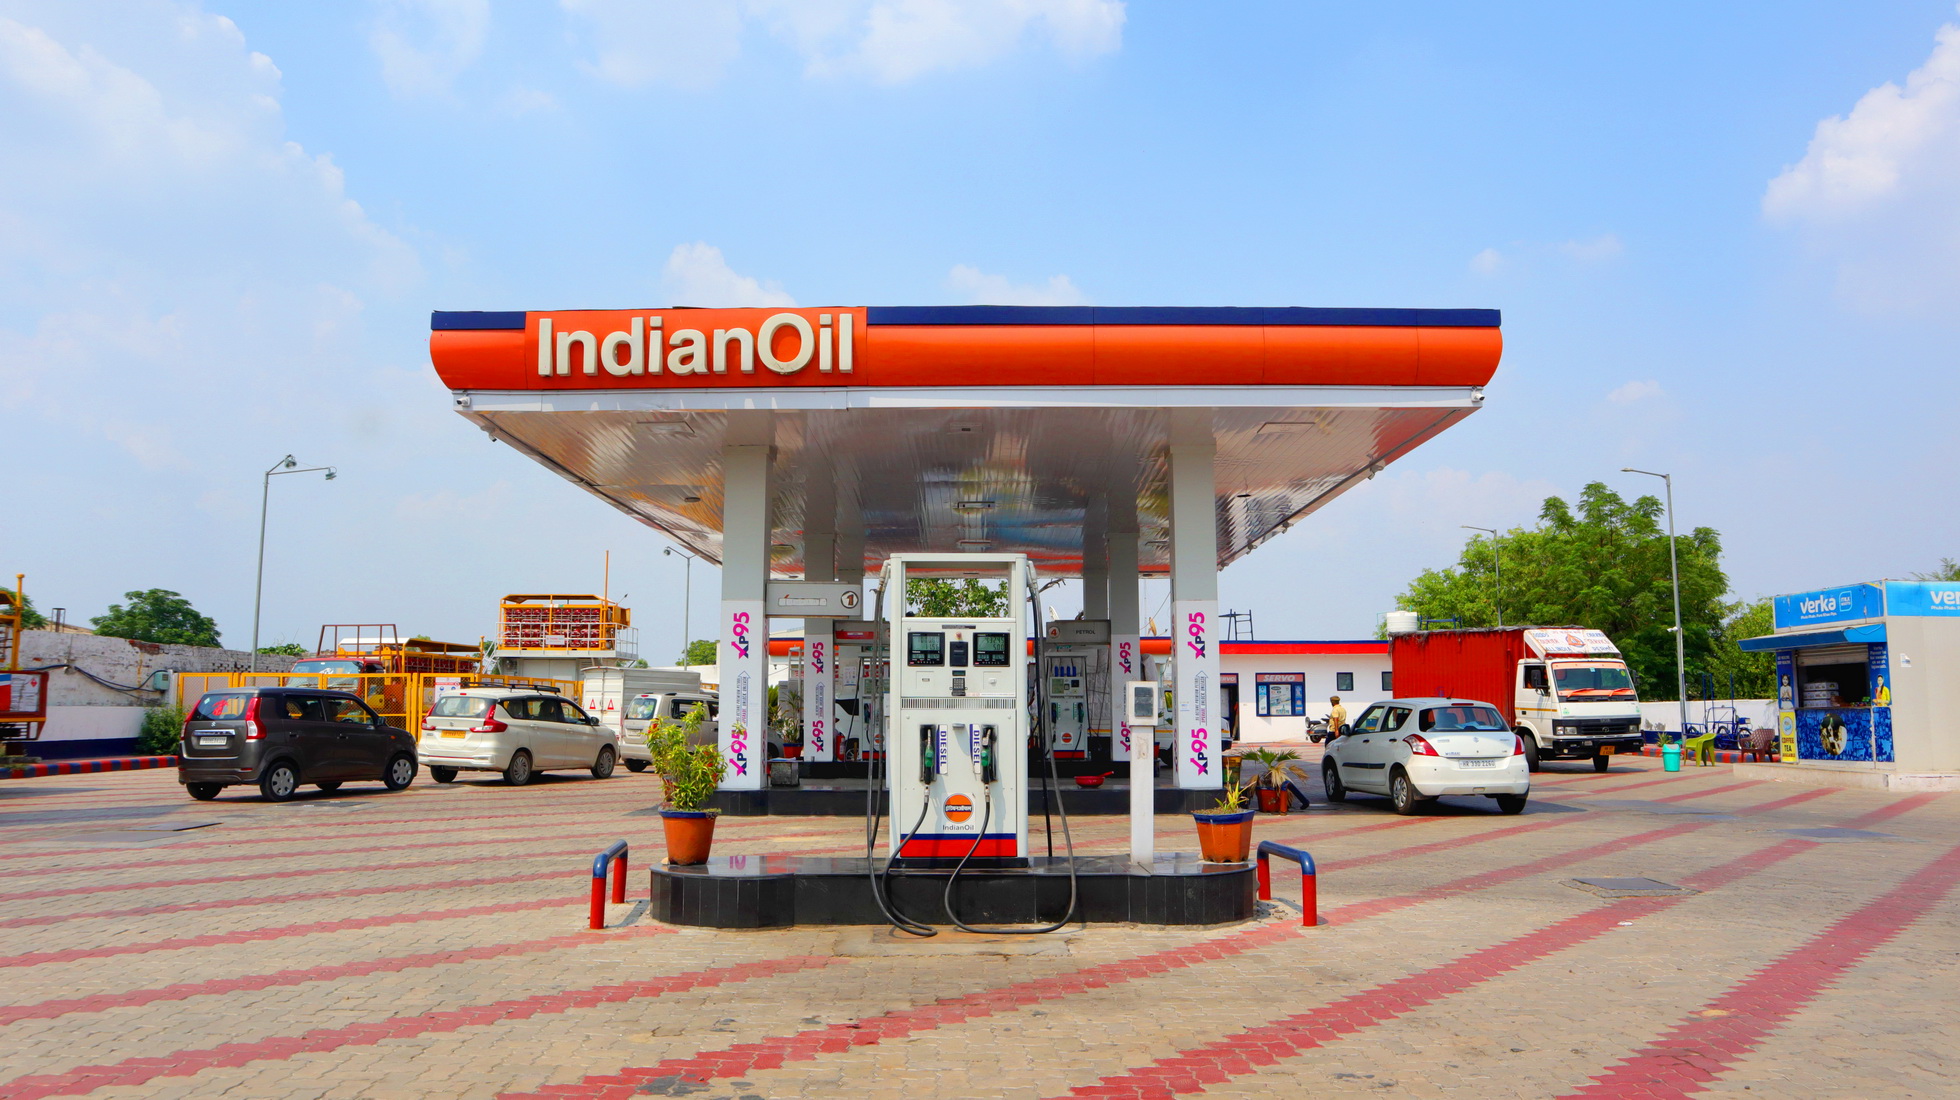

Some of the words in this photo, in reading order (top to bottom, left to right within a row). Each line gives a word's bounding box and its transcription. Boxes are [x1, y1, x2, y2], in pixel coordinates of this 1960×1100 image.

[538, 313, 854, 378] IndianOil
[847, 594, 854, 606] 1
[1050, 628, 1058, 636] 4
[1263, 674, 1296, 682] SERVO
